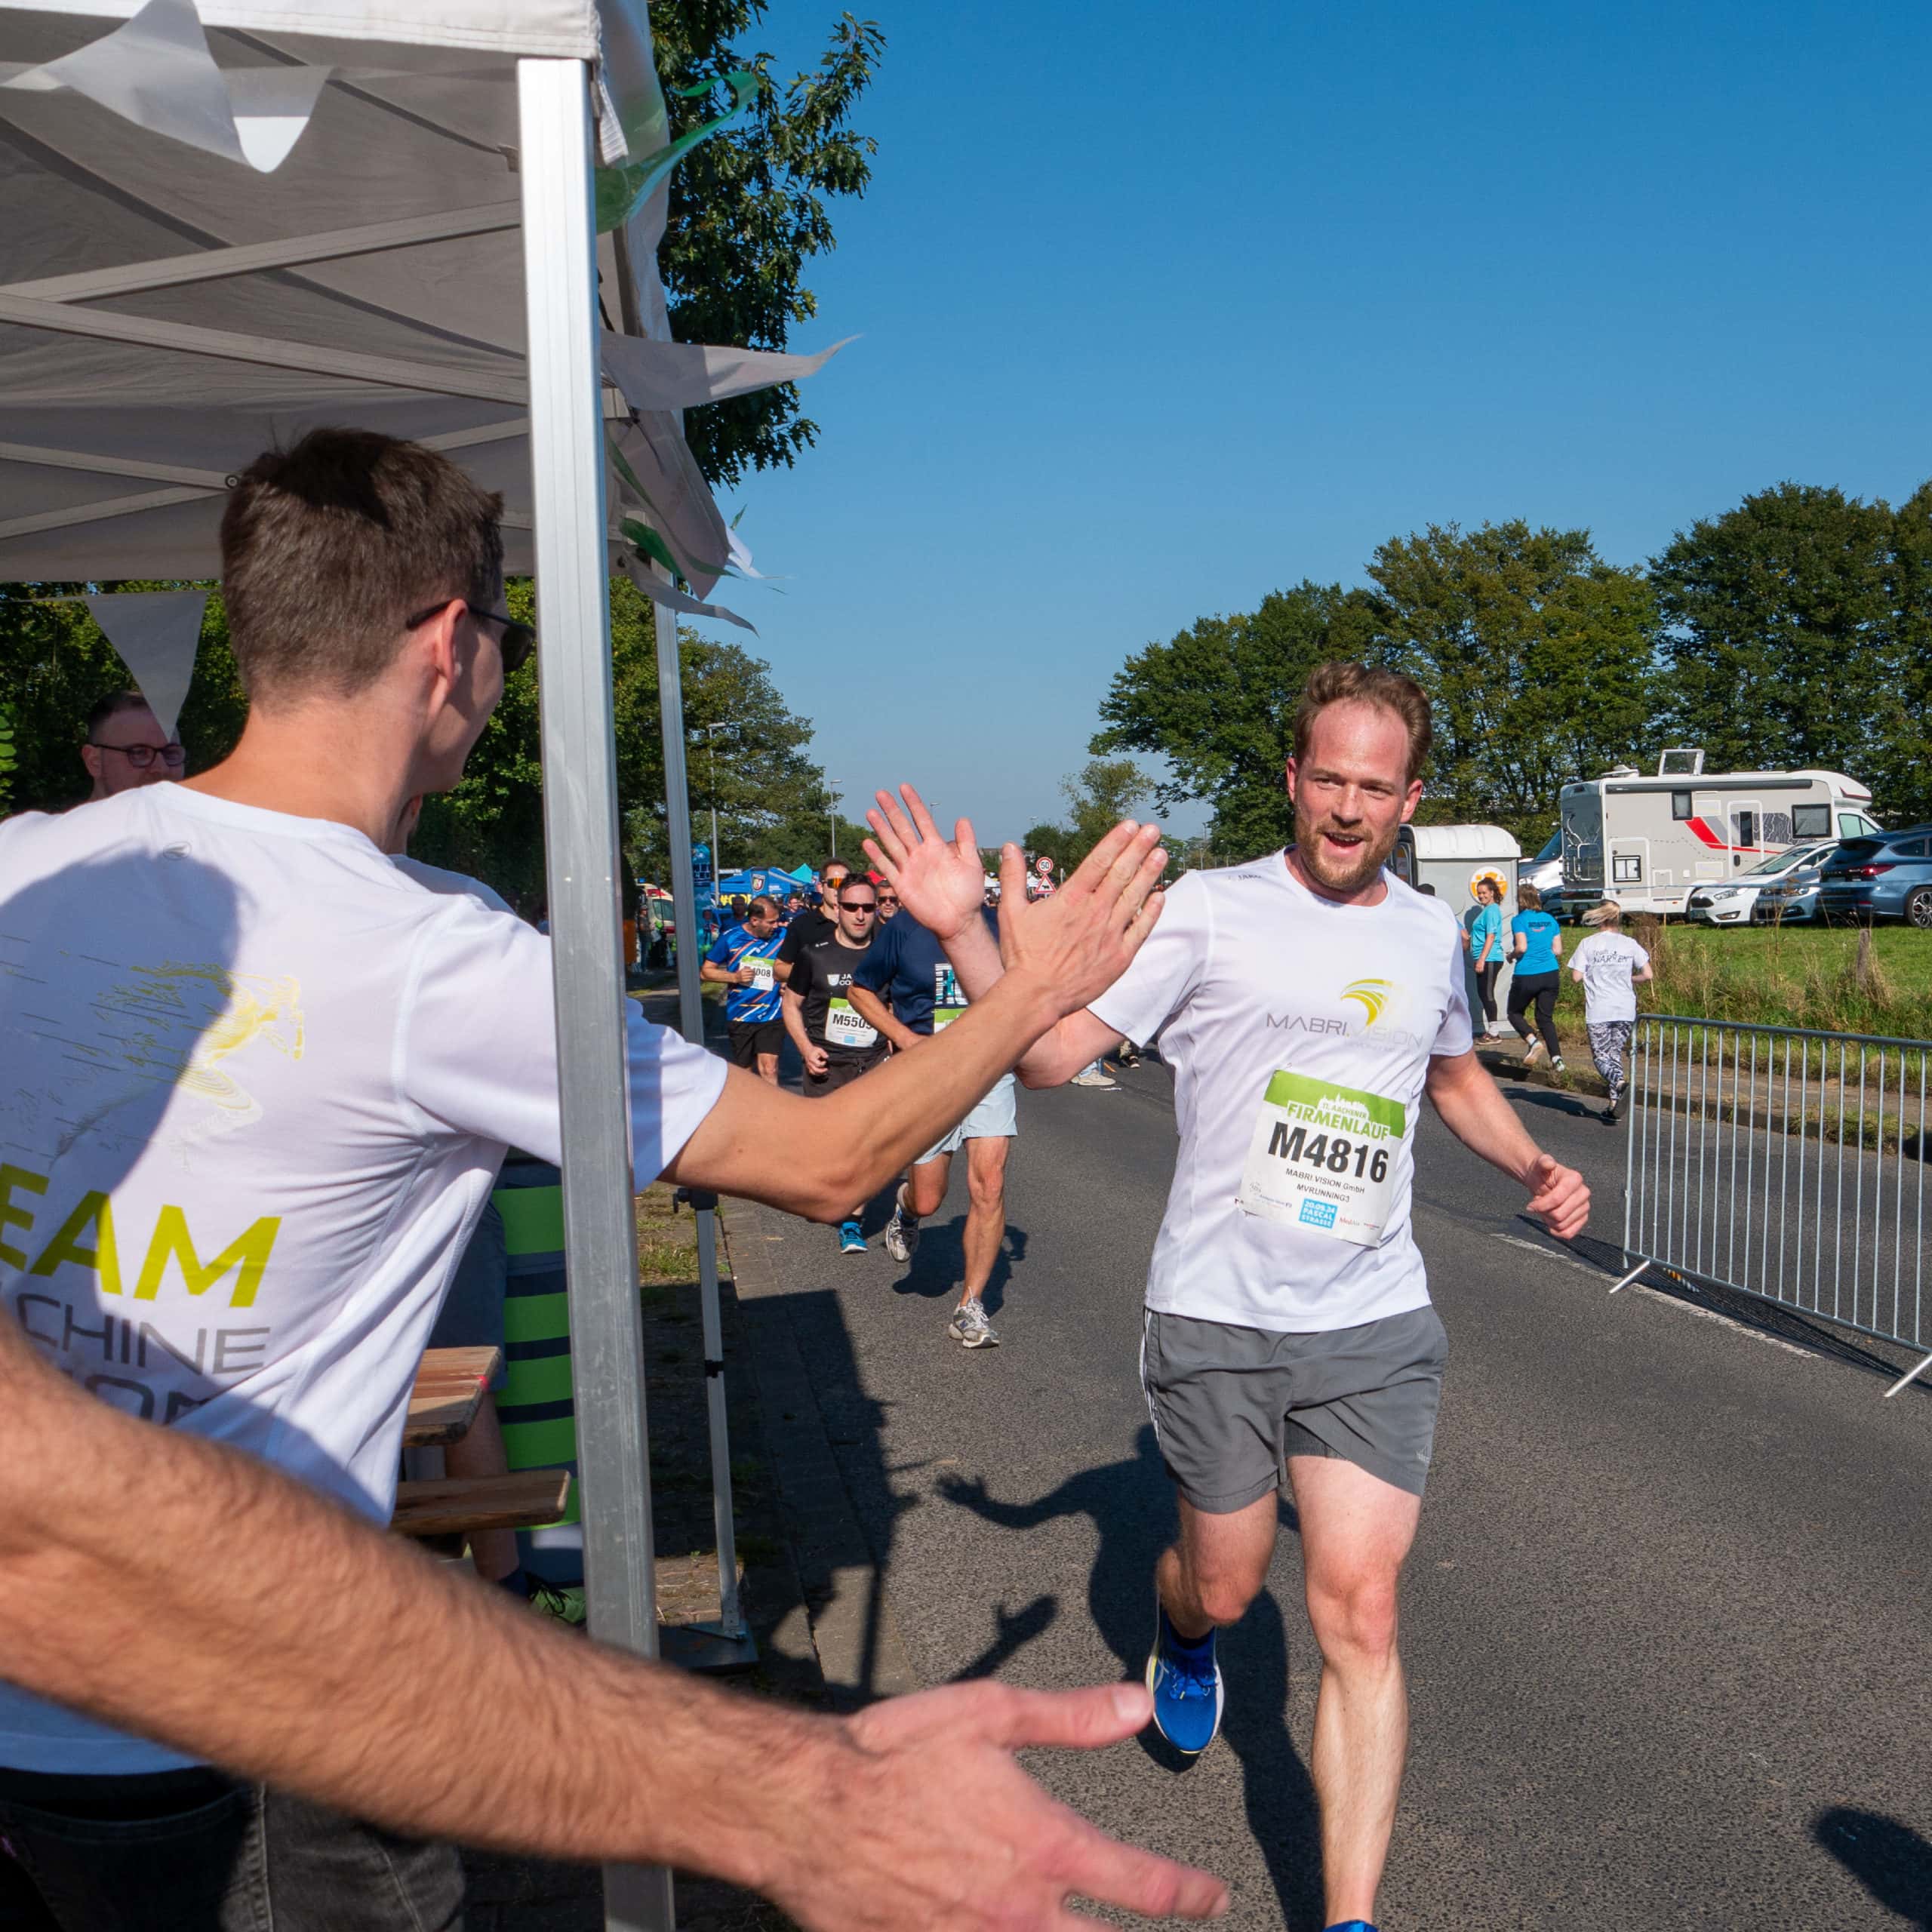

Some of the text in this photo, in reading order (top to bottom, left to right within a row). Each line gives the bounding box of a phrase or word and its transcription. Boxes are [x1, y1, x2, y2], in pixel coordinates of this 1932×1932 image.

[1041, 861, 1050, 869] 50
[754, 968, 771, 978] 008
[1332, 1105, 1367, 1118] AACHENER
[1286, 1102, 1389, 1141] FIRMENLAUF
[1268, 1121, 1389, 1183] M4816
[1297, 1183, 1350, 1202] MVRUNNING3
[1343, 1183, 1364, 1194] GmbH
[1303, 1208, 1334, 1221] PASCAL
[14, 1292, 270, 1376] CHINE
